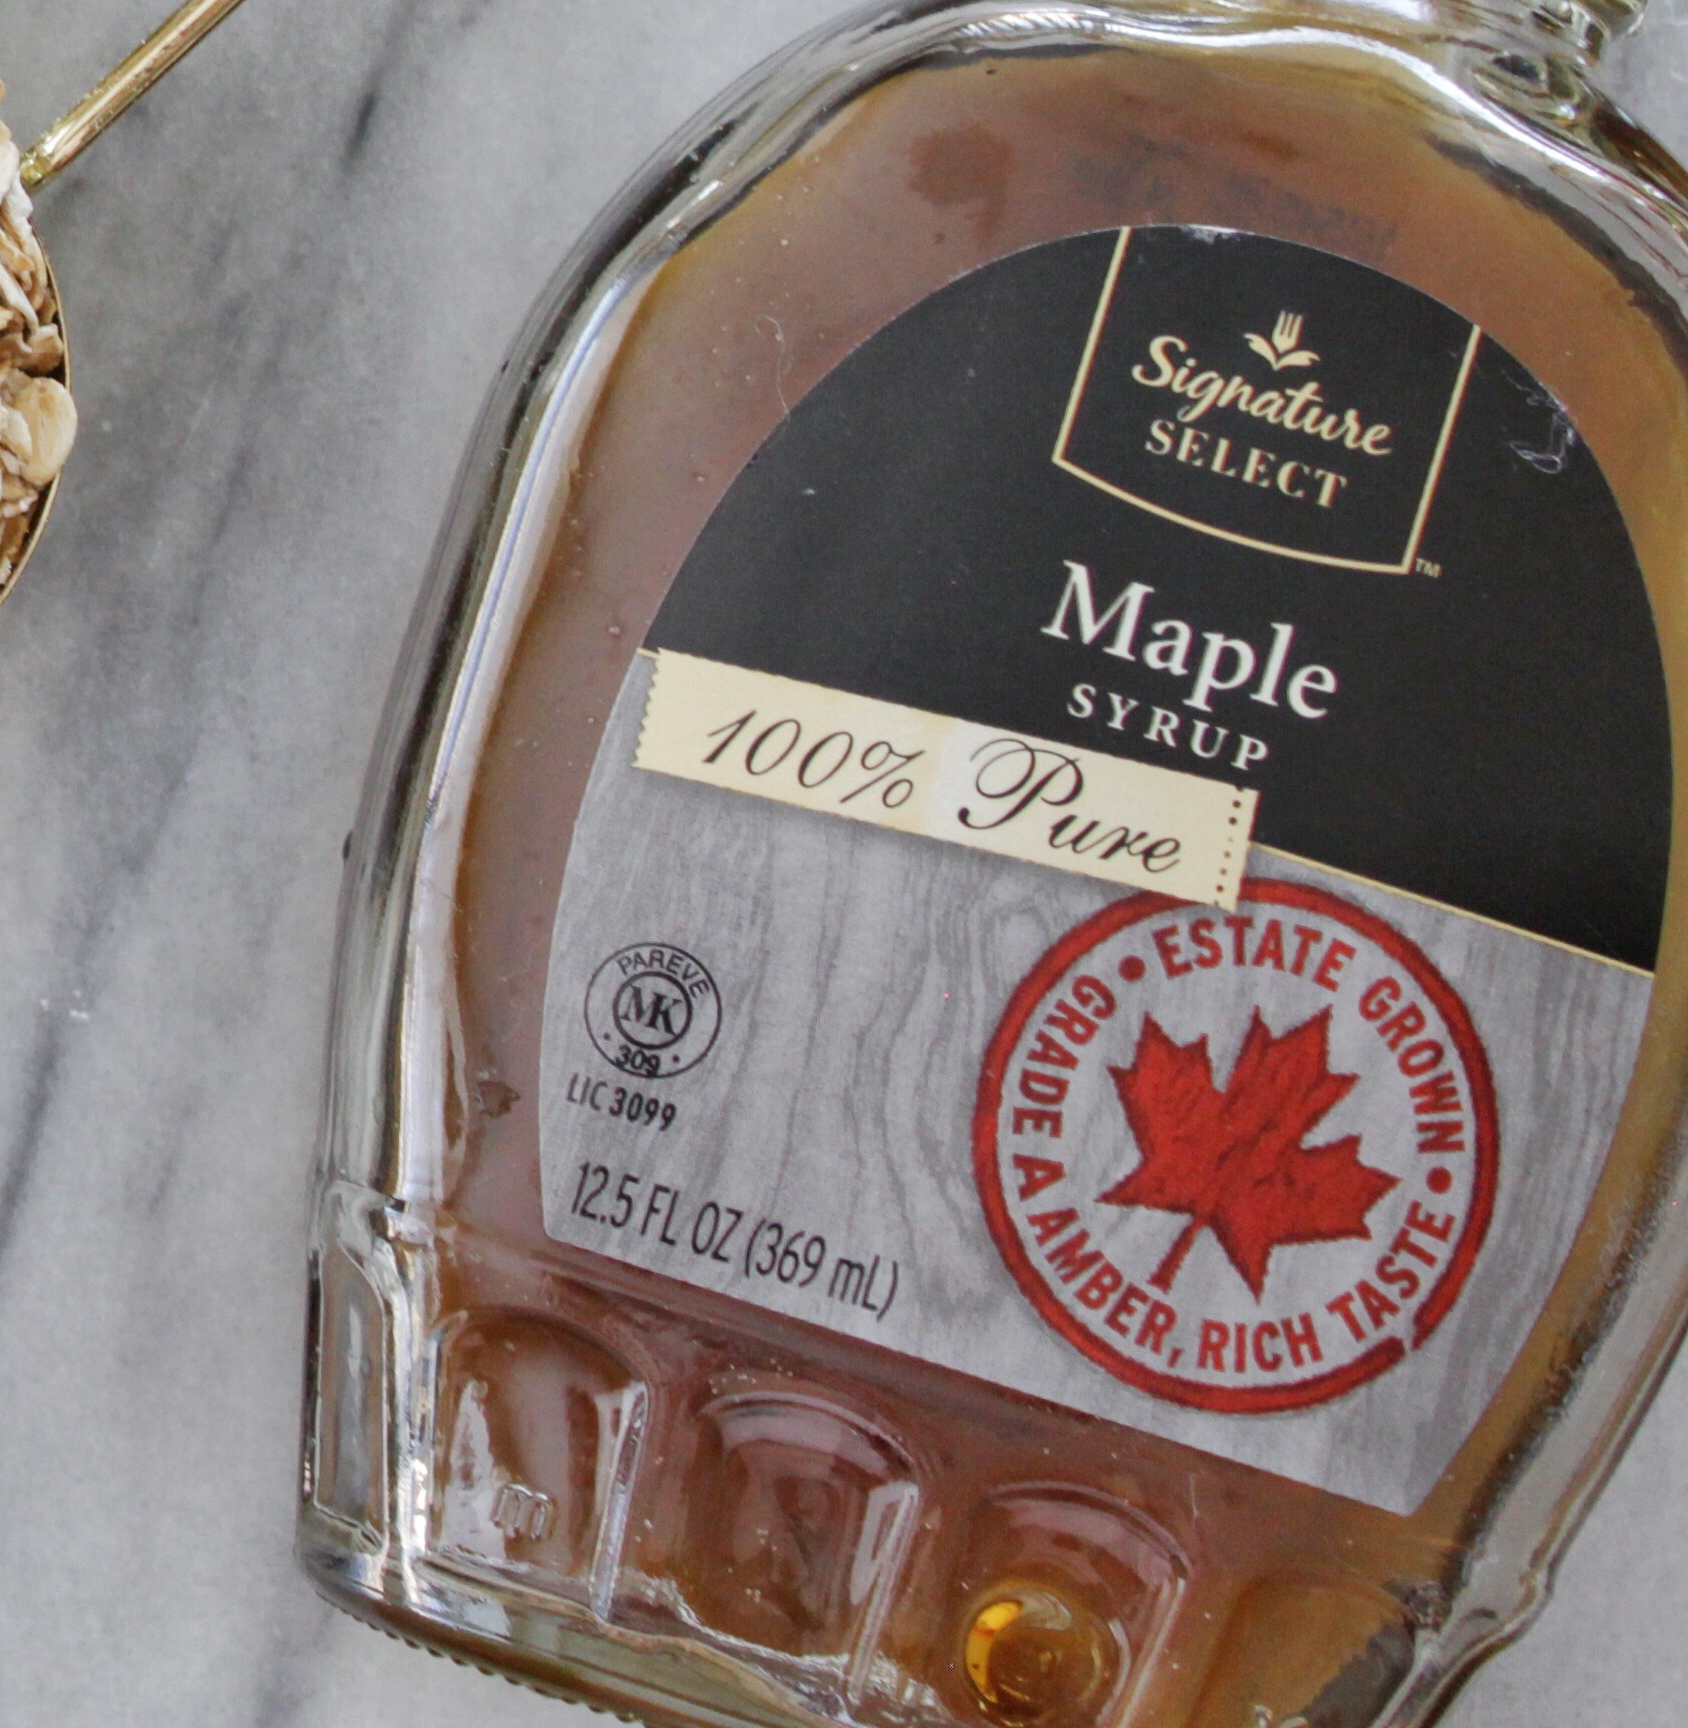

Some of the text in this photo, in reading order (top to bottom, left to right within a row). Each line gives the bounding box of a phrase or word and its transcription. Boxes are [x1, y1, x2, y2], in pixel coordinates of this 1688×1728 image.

[1131, 335, 1393, 456] Signature
[1145, 419, 1348, 509] SELECT
[1040, 560, 1338, 720] Maple
[1067, 683, 1270, 772] SYRUP
[702, 709, 1182, 874] 100% Pure
[616, 948, 711, 1000] PAREVE
[619, 982, 684, 1037] MK
[614, 1044, 662, 1078] 309
[1151, 915, 1466, 1154] ESTATE GROWN
[566, 1072, 678, 1132] LIC 3099
[1011, 974, 1455, 1373] GRADE A AMBER, RICH TASTE
[570, 1160, 900, 1323] 12.5 FL OZ (369 mL)
